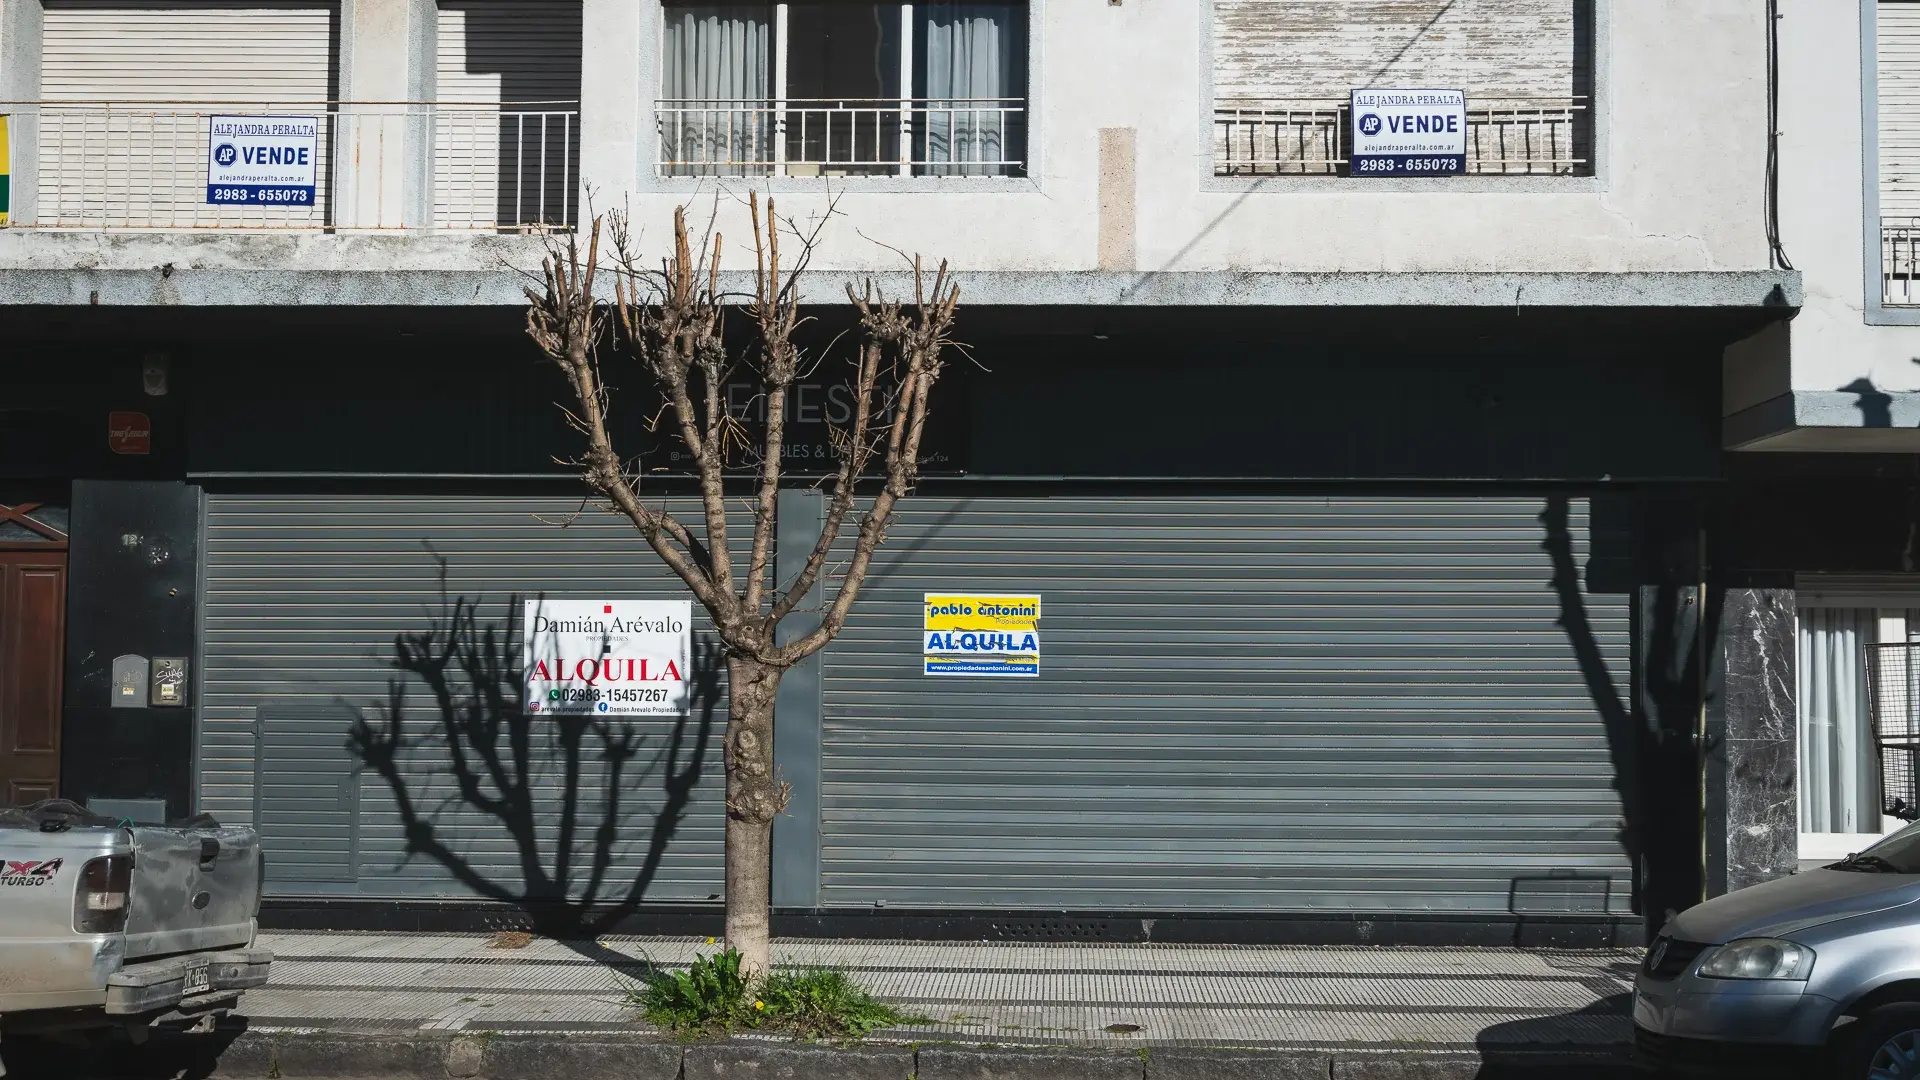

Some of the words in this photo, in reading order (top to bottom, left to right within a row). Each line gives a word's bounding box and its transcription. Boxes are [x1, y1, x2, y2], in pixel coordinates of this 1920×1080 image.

[1356, 95, 1415, 108] ALEJANDRA
[1417, 95, 1462, 104] PERALTA
[214, 124, 270, 138] ALEJANDRA
[272, 124, 315, 135] PERALTA
[1363, 117, 1379, 131] AP
[1387, 115, 1458, 133] VENDE
[1364, 144, 1455, 152] alejandraperalta.com.ar
[219, 148, 234, 162] AP
[242, 146, 309, 165] VENDE
[1360, 159, 1395, 171] 2983
[1406, 158, 1457, 171] 655073
[219, 174, 305, 182] alejandraperalta.com.ar
[214, 188, 248, 200] 2983
[258, 189, 307, 201] 655073
[745, 444, 810, 458] MUBLES
[814, 444, 825, 458] &
[930, 603, 973, 618] pablo
[978, 603, 1036, 616] antonini
[534, 615, 604, 633] Damián
[609, 615, 683, 633] Arévalo
[927, 632, 1038, 651] ALQUILA
[531, 658, 683, 687] ALQUILA
[931, 665, 1033, 673] www.propiedadesantonini.com.ar
[562, 688, 668, 702] 02983-15457267
[653, 706, 686, 714] Propiedades
[0, 876, 45, 887] TURBO
